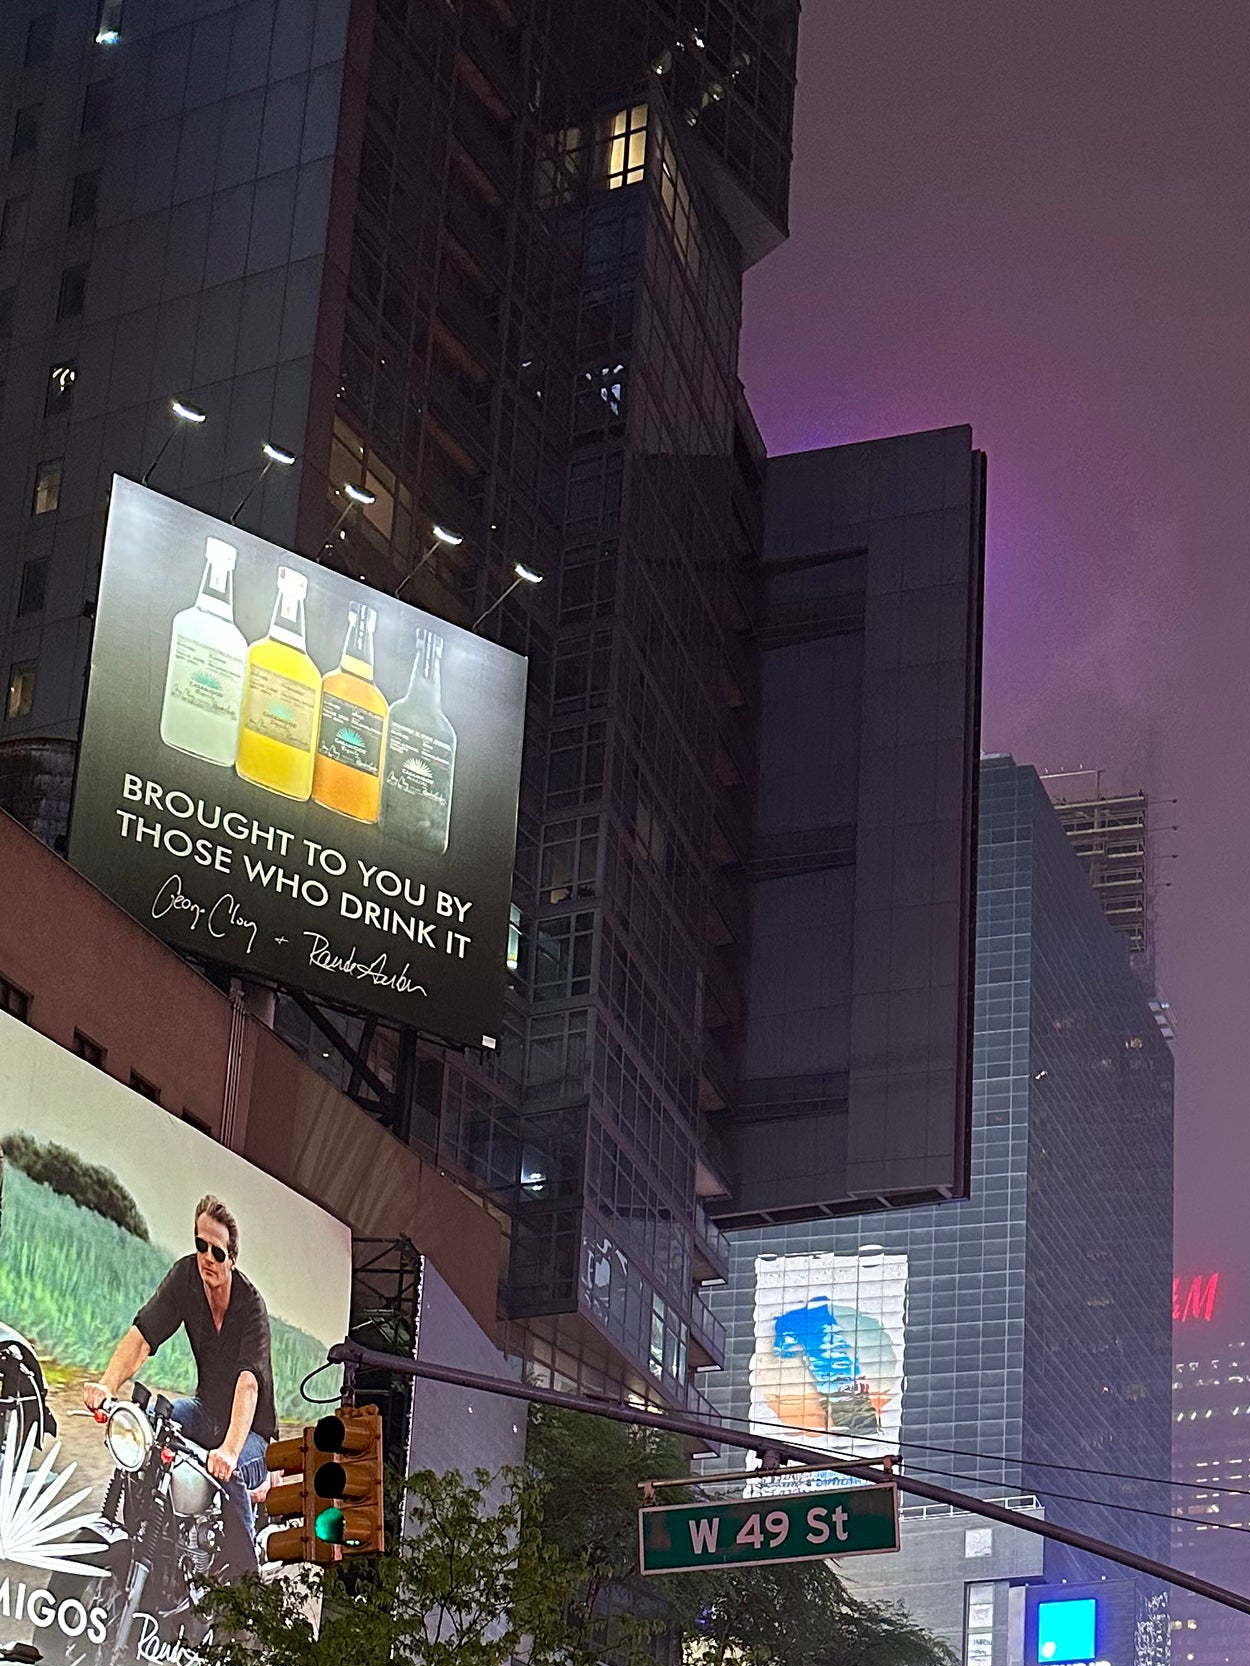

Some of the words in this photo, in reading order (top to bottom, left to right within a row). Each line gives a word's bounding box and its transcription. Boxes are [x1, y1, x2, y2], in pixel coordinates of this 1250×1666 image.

[116, 809, 233, 874] THOSE
[243, 854, 330, 907] WHO
[340, 891, 436, 949] DRINK
[446, 930, 471, 959] IT
[123, 773, 294, 856] BROUGHT
[303, 838, 347, 876] TO
[357, 859, 426, 907] YOU
[436, 889, 473, 923] BY
[688, 1517, 720, 1554] W
[736, 1511, 789, 1549] 49
[806, 1504, 849, 1544] St
